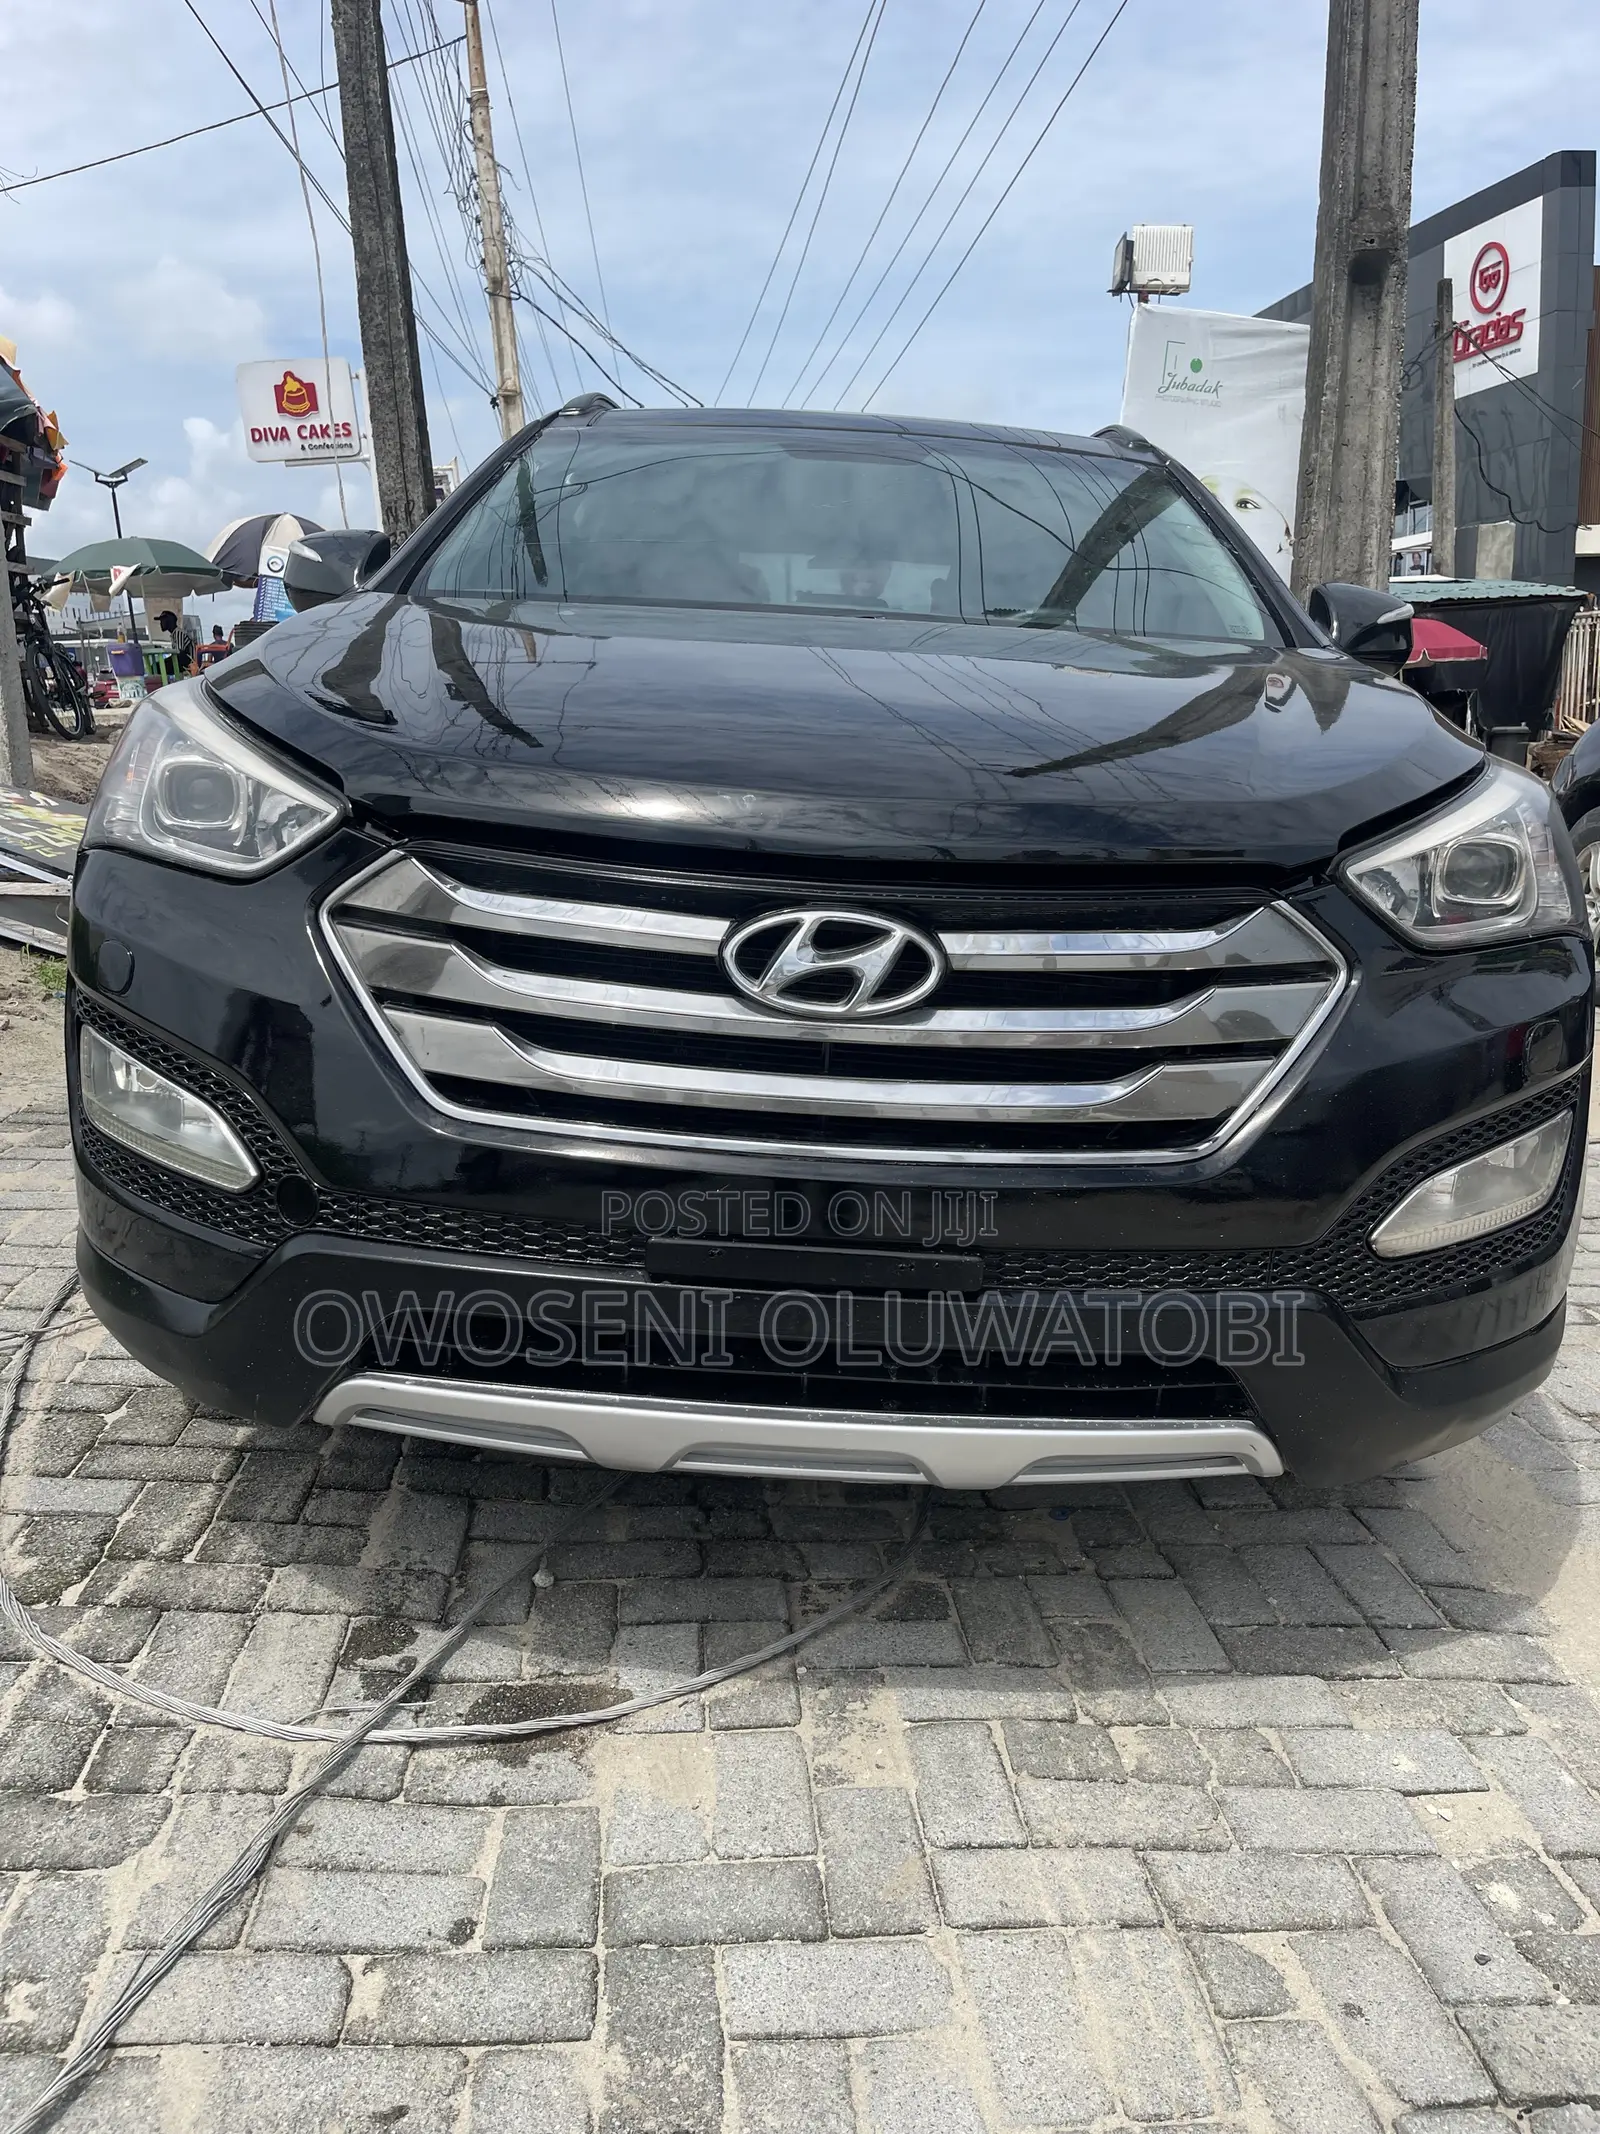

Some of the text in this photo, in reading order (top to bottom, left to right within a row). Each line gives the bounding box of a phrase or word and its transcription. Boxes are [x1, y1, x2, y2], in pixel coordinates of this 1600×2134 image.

[1157, 372, 1223, 399] Jubadak
[250, 422, 352, 443] DIVA CAKES
[300, 443, 306, 451] &
